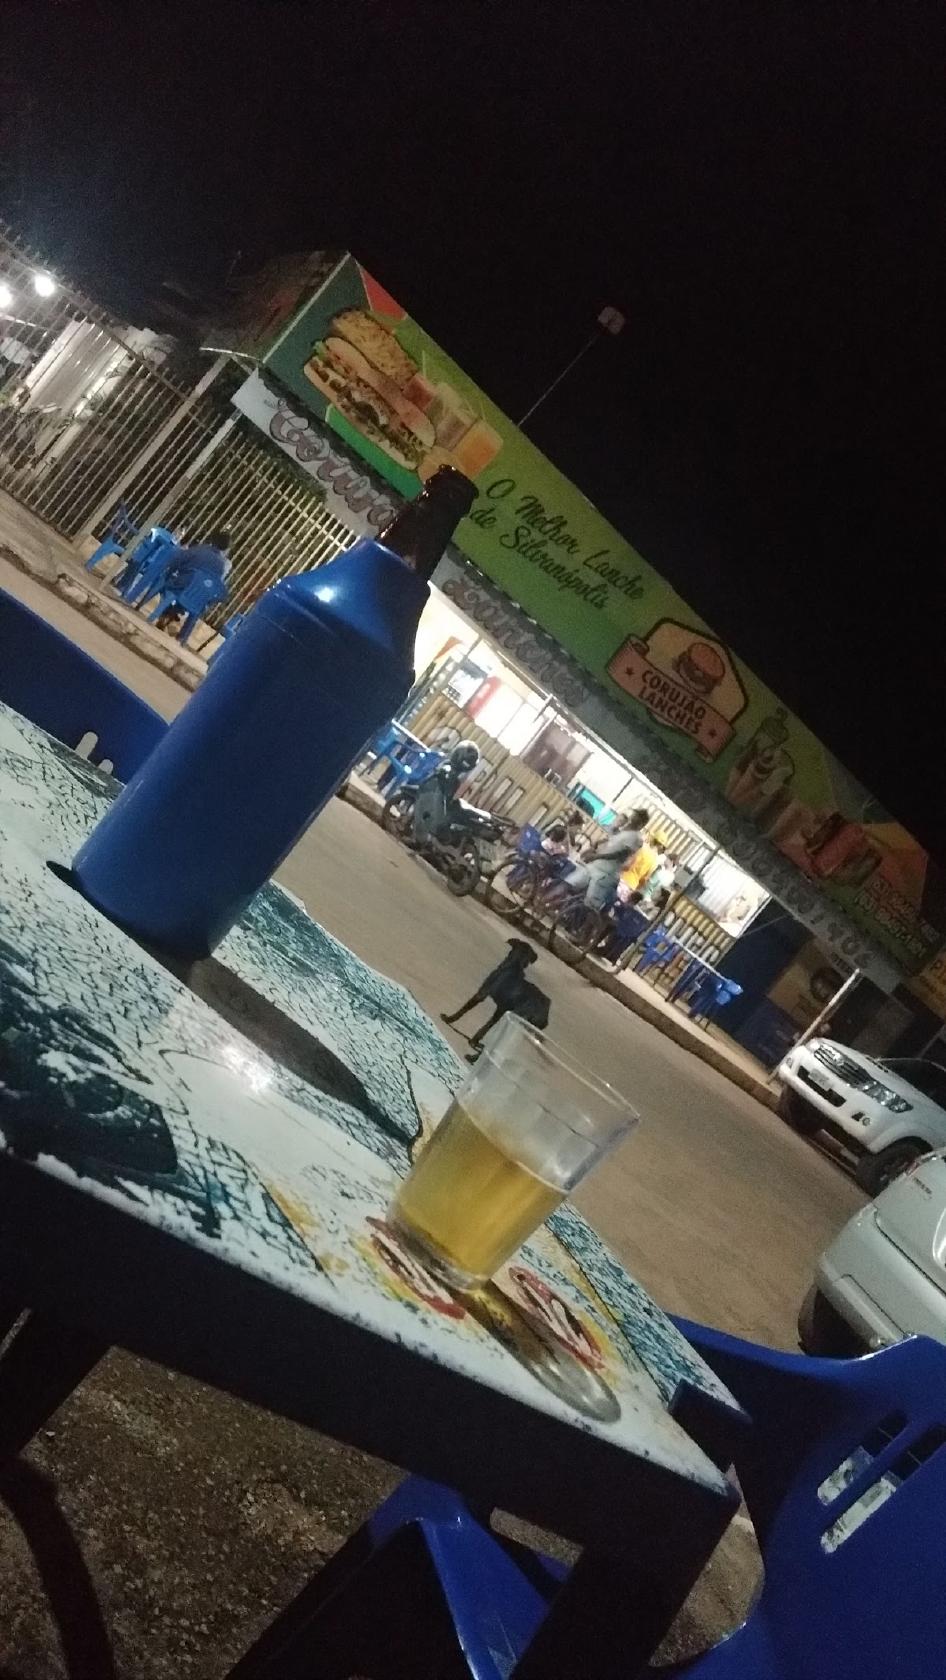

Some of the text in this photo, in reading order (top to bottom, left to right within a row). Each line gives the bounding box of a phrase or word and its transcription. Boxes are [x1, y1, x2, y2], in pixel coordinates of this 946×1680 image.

[470, 507, 498, 530] de
[486, 478, 645, 600] O Melhor Lanche
[638, 685, 702, 734] LANCHES
